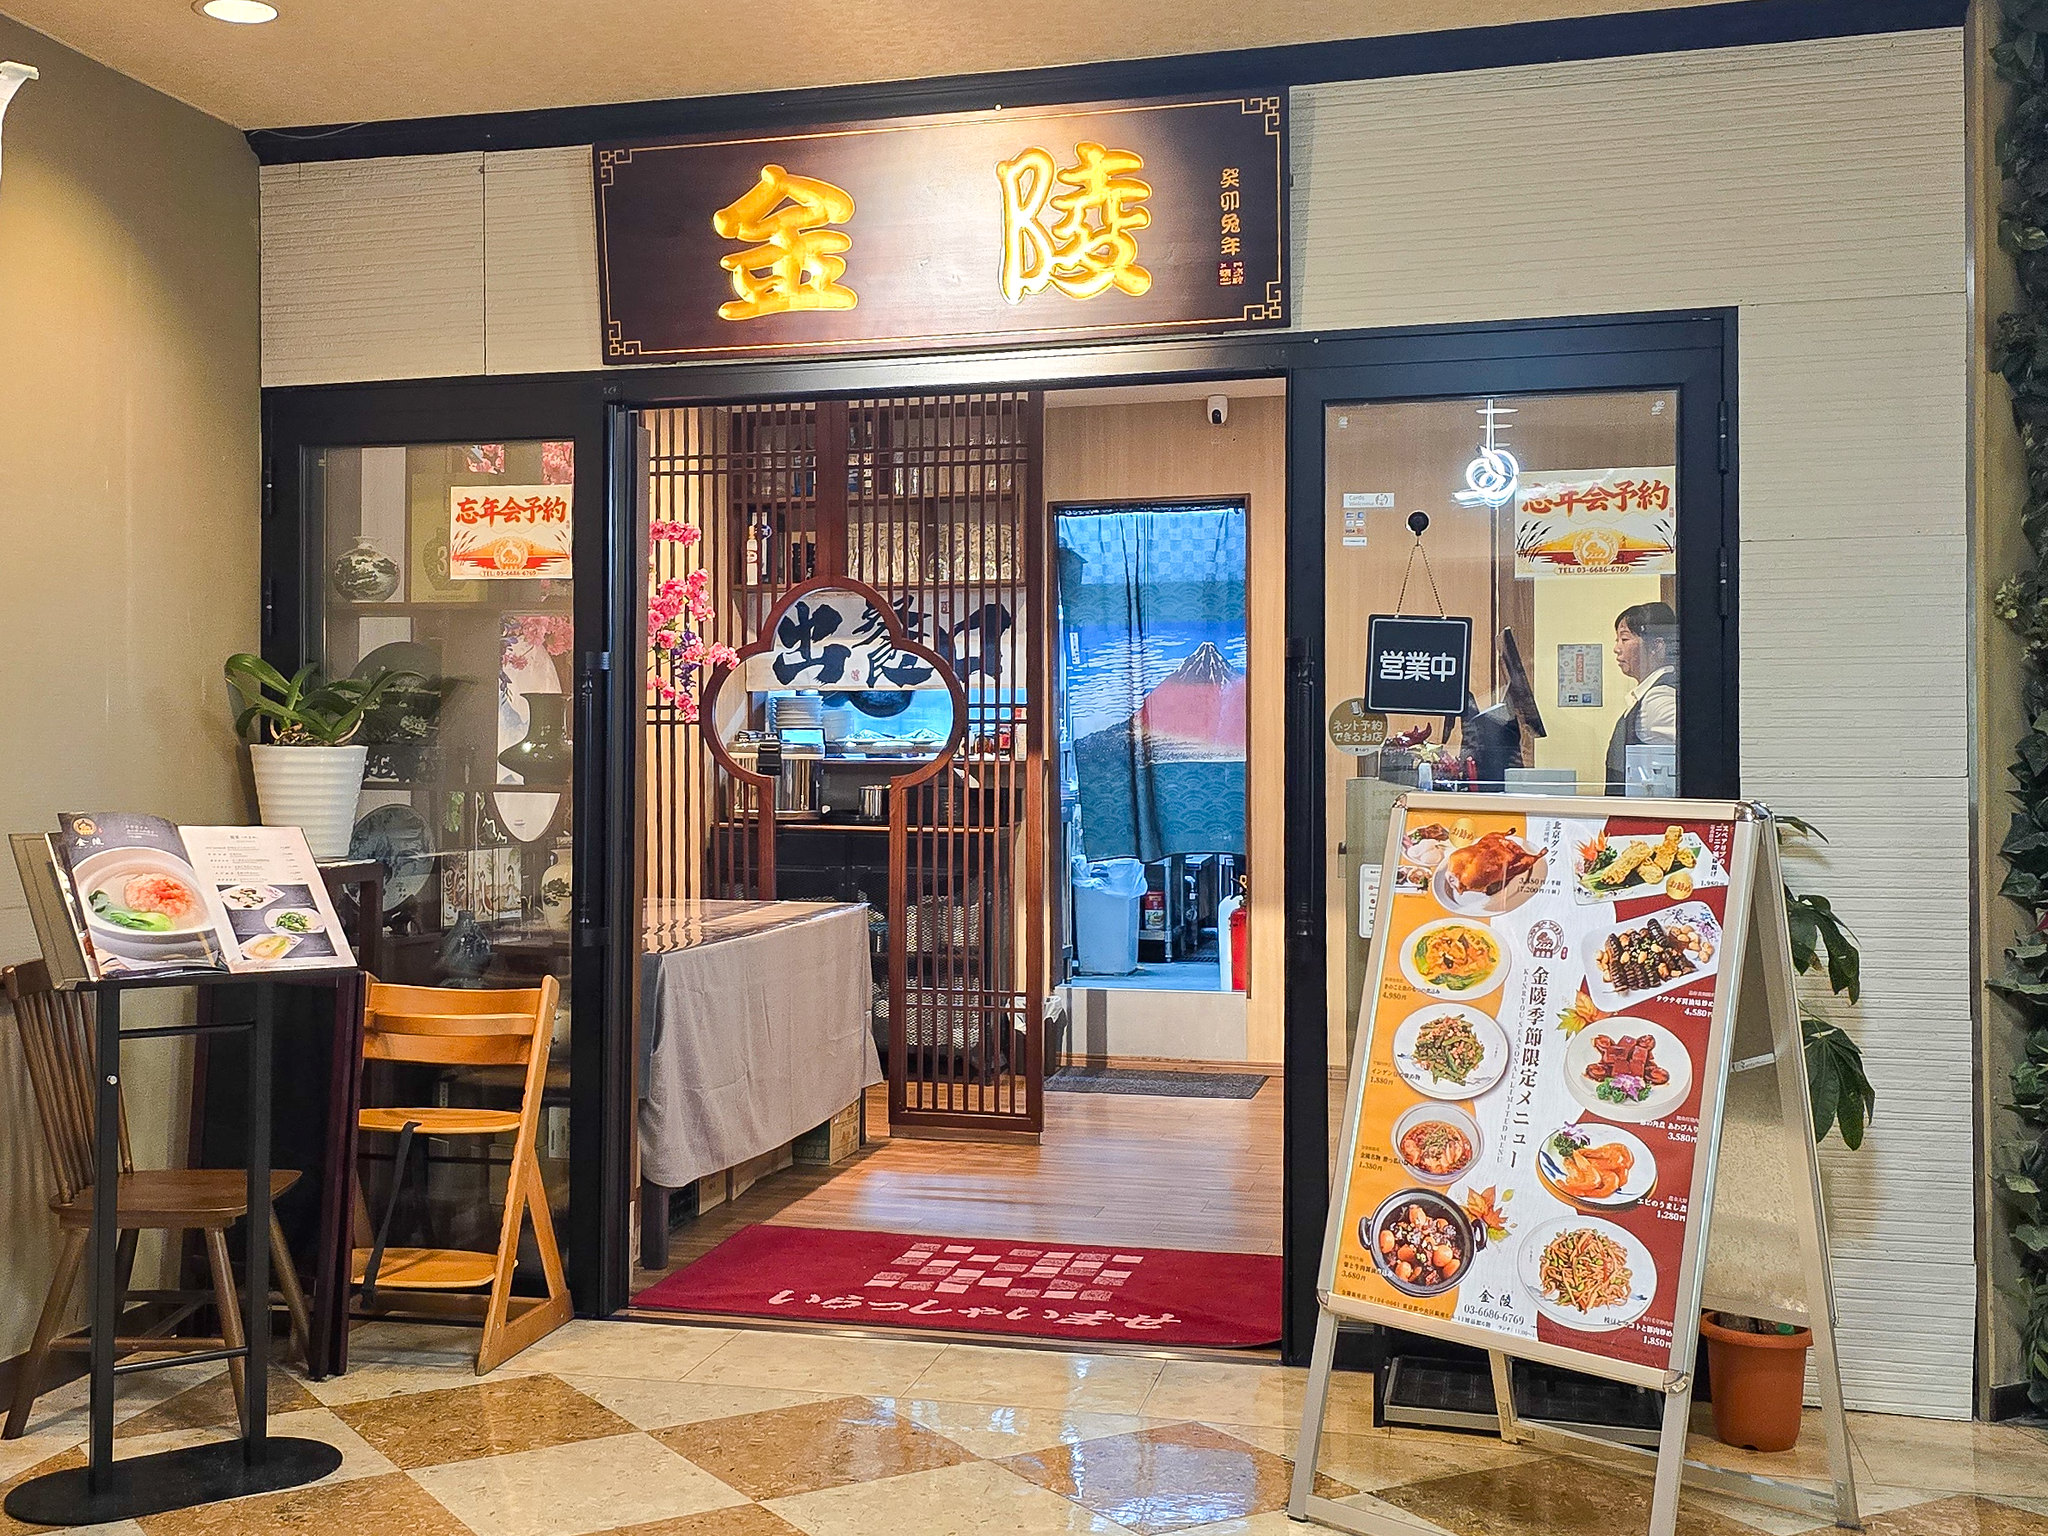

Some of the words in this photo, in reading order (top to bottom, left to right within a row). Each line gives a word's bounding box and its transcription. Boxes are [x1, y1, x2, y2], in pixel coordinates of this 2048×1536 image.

[1522, 480, 1670, 517] 忘年会予約
[455, 496, 567, 527] 忘年会予約
[1380, 650, 1456, 682] 営業中
[1333, 719, 1383, 731] ネット予約
[1333, 732, 1383, 742] できるお店
[1548, 821, 1562, 866] 北京ダック
[1511, 966, 1549, 1168] 金陵季節限定メニュー
[1667, 1132, 1698, 1143] 3,580円
[1656, 1210, 1686, 1222] 1,280円
[768, 1289, 1182, 1329] いらっしゃいませ
[1478, 1289, 1514, 1309] 金陵
[1463, 1303, 1525, 1326] 03-6686-6769
[1643, 1335, 1672, 1349] 1,850円
